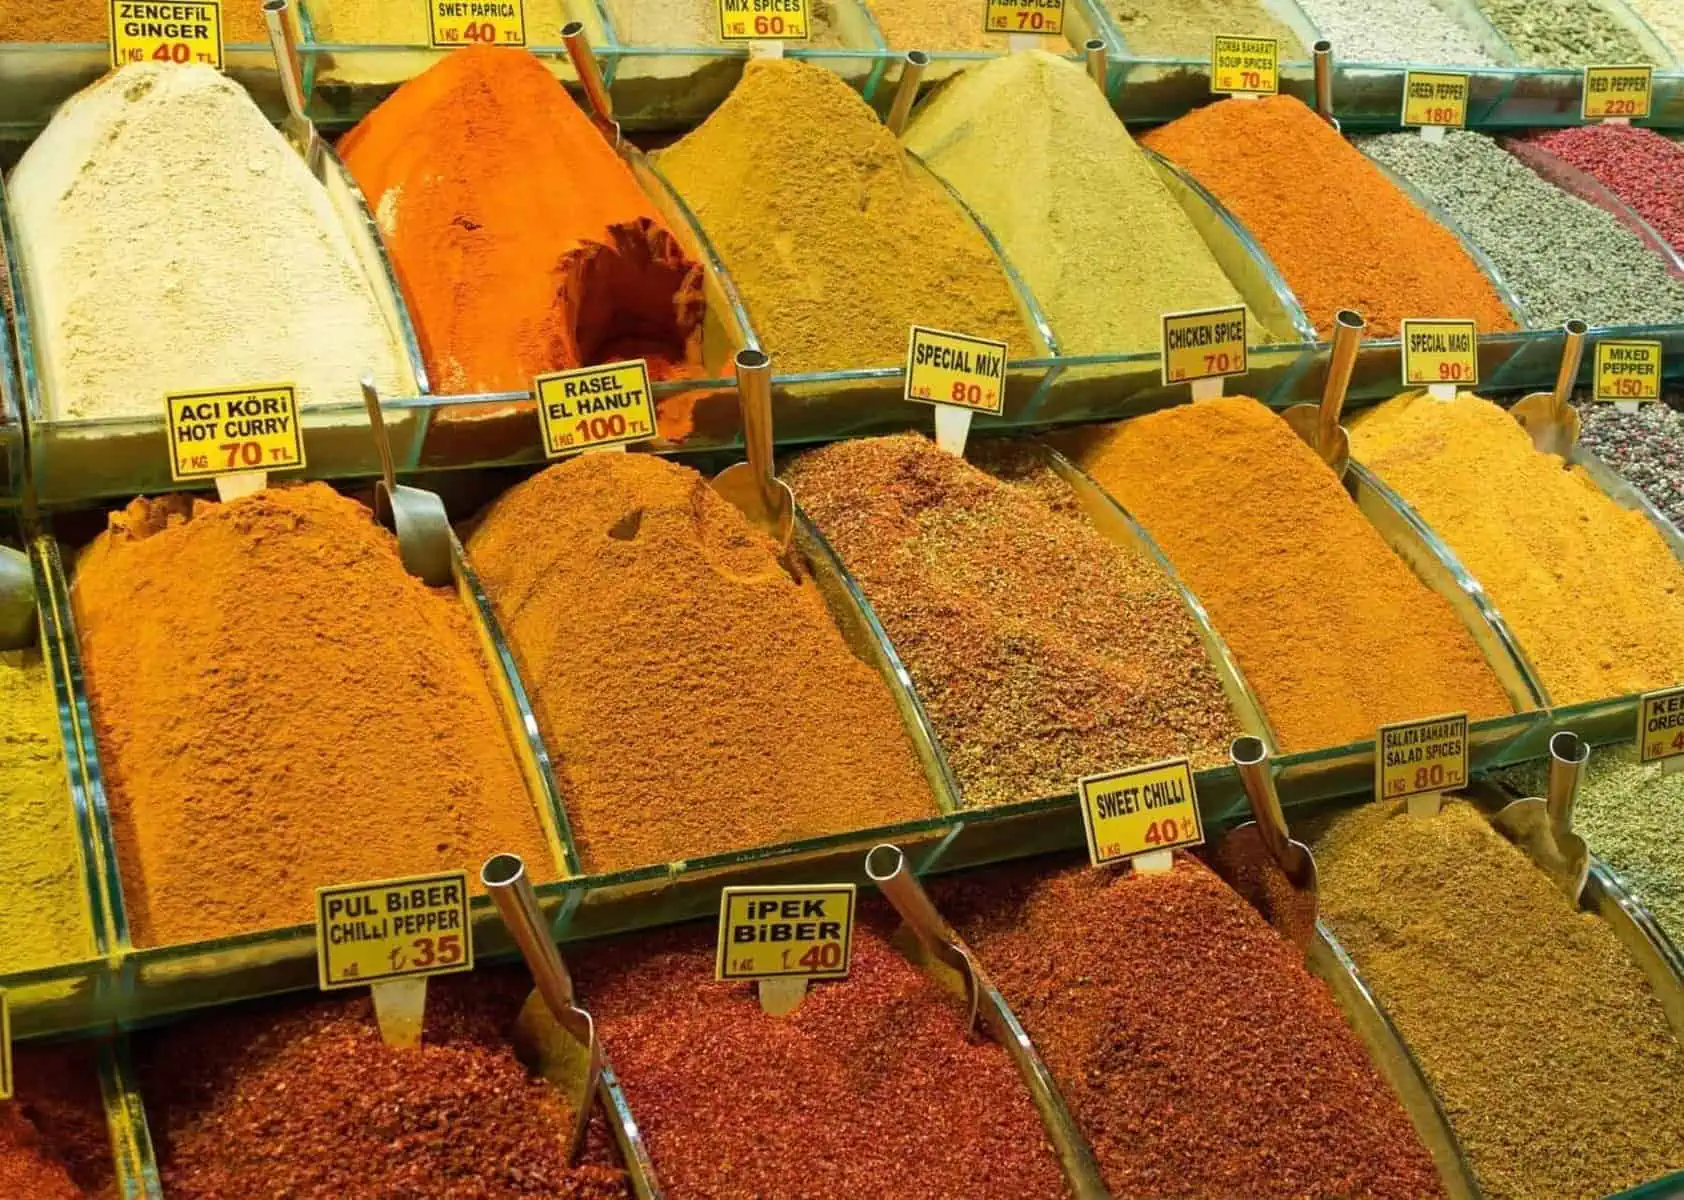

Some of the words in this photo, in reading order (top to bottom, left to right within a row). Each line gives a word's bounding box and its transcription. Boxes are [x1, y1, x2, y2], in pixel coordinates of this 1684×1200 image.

[439, 3, 468, 16] SWET
[471, 3, 515, 17] PAPRICA
[754, 0, 801, 12] SPICES
[754, 16, 784, 35] 60
[788, 24, 804, 34] TL
[1016, 12, 1044, 29] 70
[124, 23, 209, 39] GINGER
[463, 21, 496, 42] 40
[504, 31, 521, 41] TL
[152, 43, 191, 64] 40
[196, 52, 216, 64] TL
[1219, 56, 1241, 68] SOUP
[1244, 57, 1273, 70] SPICES
[1240, 71, 1260, 88] 70
[1590, 76, 1608, 92] RED
[1610, 76, 1647, 92] PEPPER
[1411, 82, 1433, 98] GREEN
[1436, 83, 1464, 100] PEPPER
[1424, 107, 1452, 122] 180
[1604, 99, 1635, 114] 220
[1169, 326, 1213, 351] CHICKEN
[1215, 321, 1242, 344] SPICE
[1411, 333, 1447, 352] SPECIAL
[916, 343, 972, 374] SPECIAL
[1203, 353, 1229, 373] 70
[1609, 348, 1649, 361] MIXED
[1439, 362, 1461, 380] 90
[1603, 362, 1654, 375] PEPPER
[564, 375, 623, 398] RASEL
[952, 381, 982, 405] 80
[1613, 378, 1642, 396] 150
[180, 402, 221, 421] ACI
[549, 402, 573, 420] EL
[576, 389, 643, 415] HANUT
[178, 423, 218, 442] HOT
[224, 416, 290, 438] CURRY
[575, 414, 626, 442] 100
[629, 420, 649, 433] TL
[219, 441, 262, 469] 70
[269, 446, 293, 461] TL
[1387, 728, 1419, 748] SALATA
[1387, 747, 1423, 767] SALAD
[1426, 739, 1461, 761] SPICES
[1414, 763, 1445, 788] 80
[1446, 769, 1461, 783] TL
[1096, 787, 1140, 819] SWEET
[1143, 777, 1185, 809] CHILLI
[1144, 819, 1179, 844] 40
[328, 896, 378, 920] PUL
[393, 908, 460, 936] PEPPER
[412, 934, 462, 967] 35
[799, 943, 842, 971] 40
